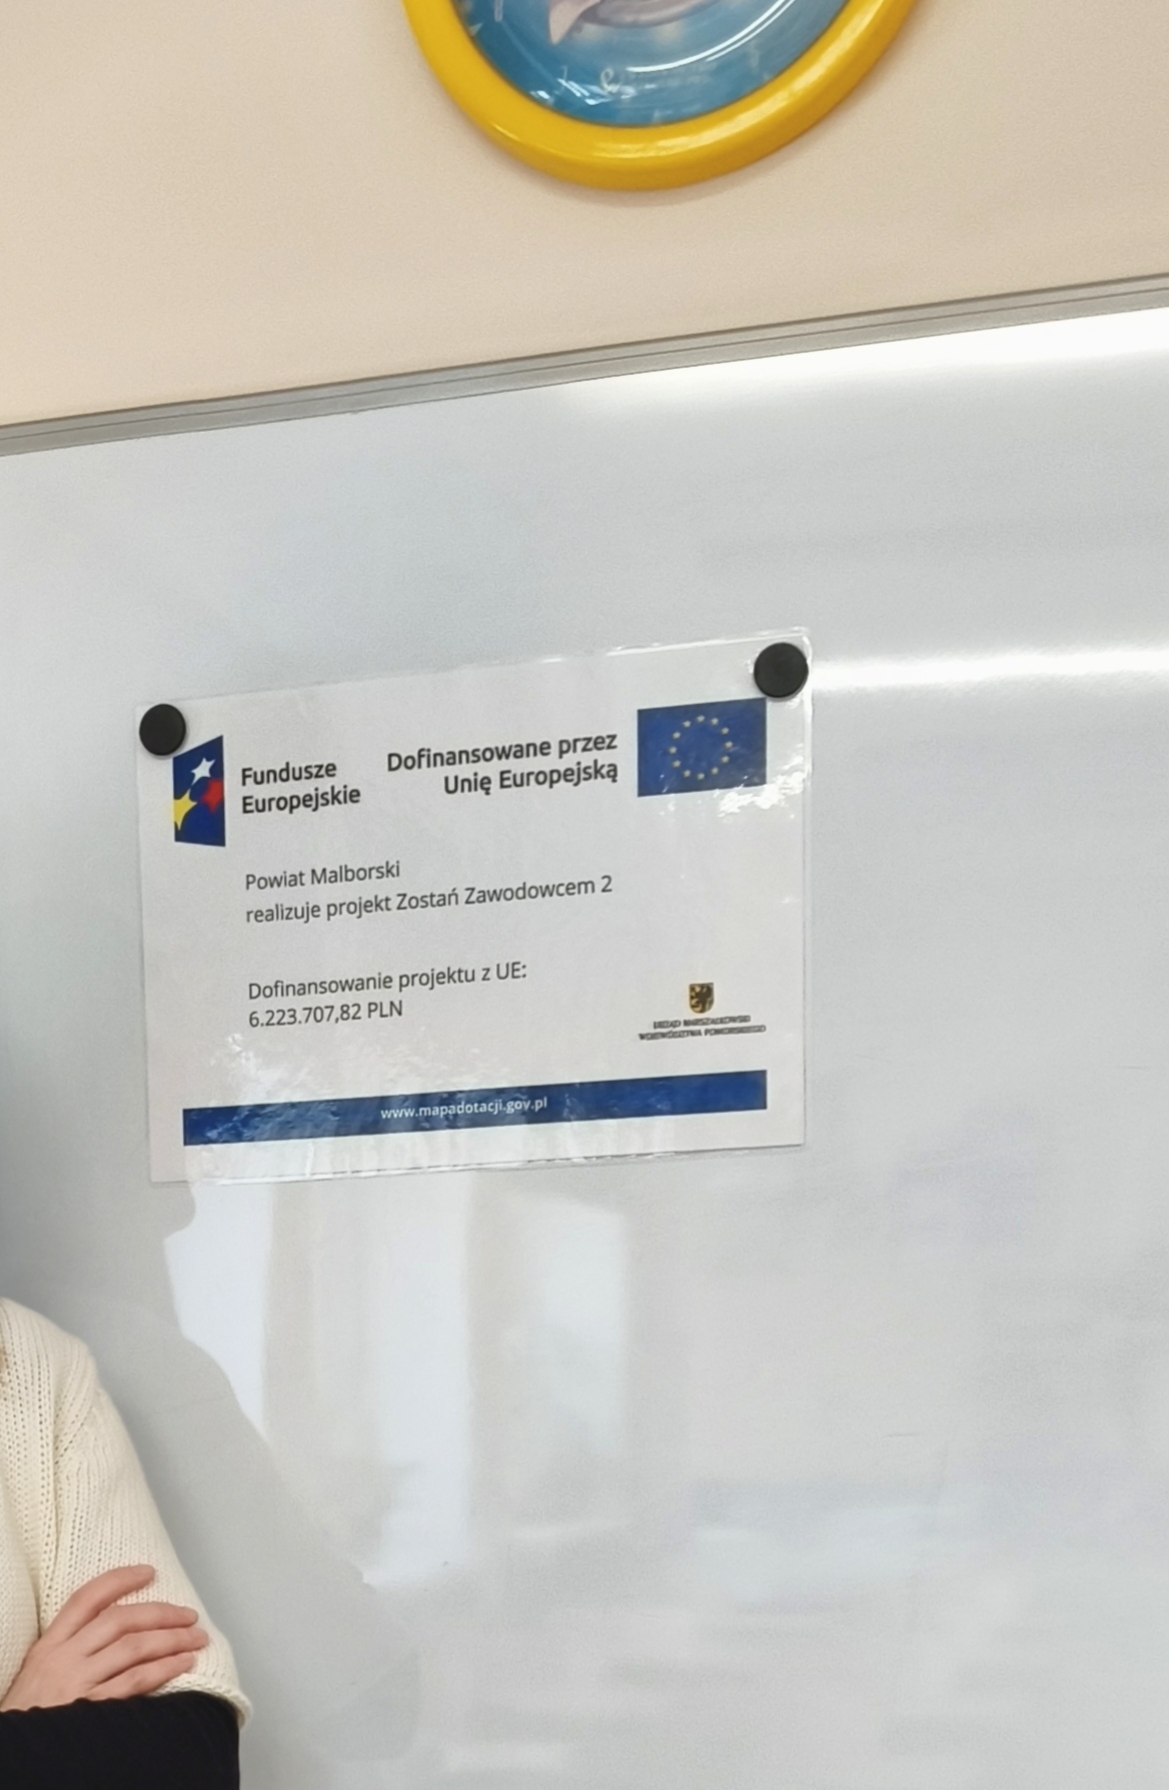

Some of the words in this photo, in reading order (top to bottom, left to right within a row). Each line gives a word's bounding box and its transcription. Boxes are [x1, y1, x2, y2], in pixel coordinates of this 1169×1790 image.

[387, 738, 552, 772] Dofinansowane
[558, 734, 618, 760] przez
[241, 760, 337, 787] Fundusze
[444, 772, 492, 796] Unię
[499, 759, 619, 790] Europejską
[242, 785, 361, 814] Europejskie
[245, 869, 305, 890] Powiat
[310, 860, 401, 885] Malborski
[246, 899, 321, 924] realizuje
[326, 894, 392, 921] projekt
[396, 886, 459, 911] Zostań
[464, 876, 595, 905] Zawodowcem
[601, 875, 613, 892] 2
[248, 972, 393, 999] Dofinansowanie
[398, 966, 476, 992] projektu
[481, 966, 491, 981] z
[496, 961, 528, 981] UE:
[249, 1004, 362, 1028] 6.223.707,82
[367, 1000, 403, 1018] PLN
[380, 1096, 548, 1120] www.mapadotacji.gov.pl
